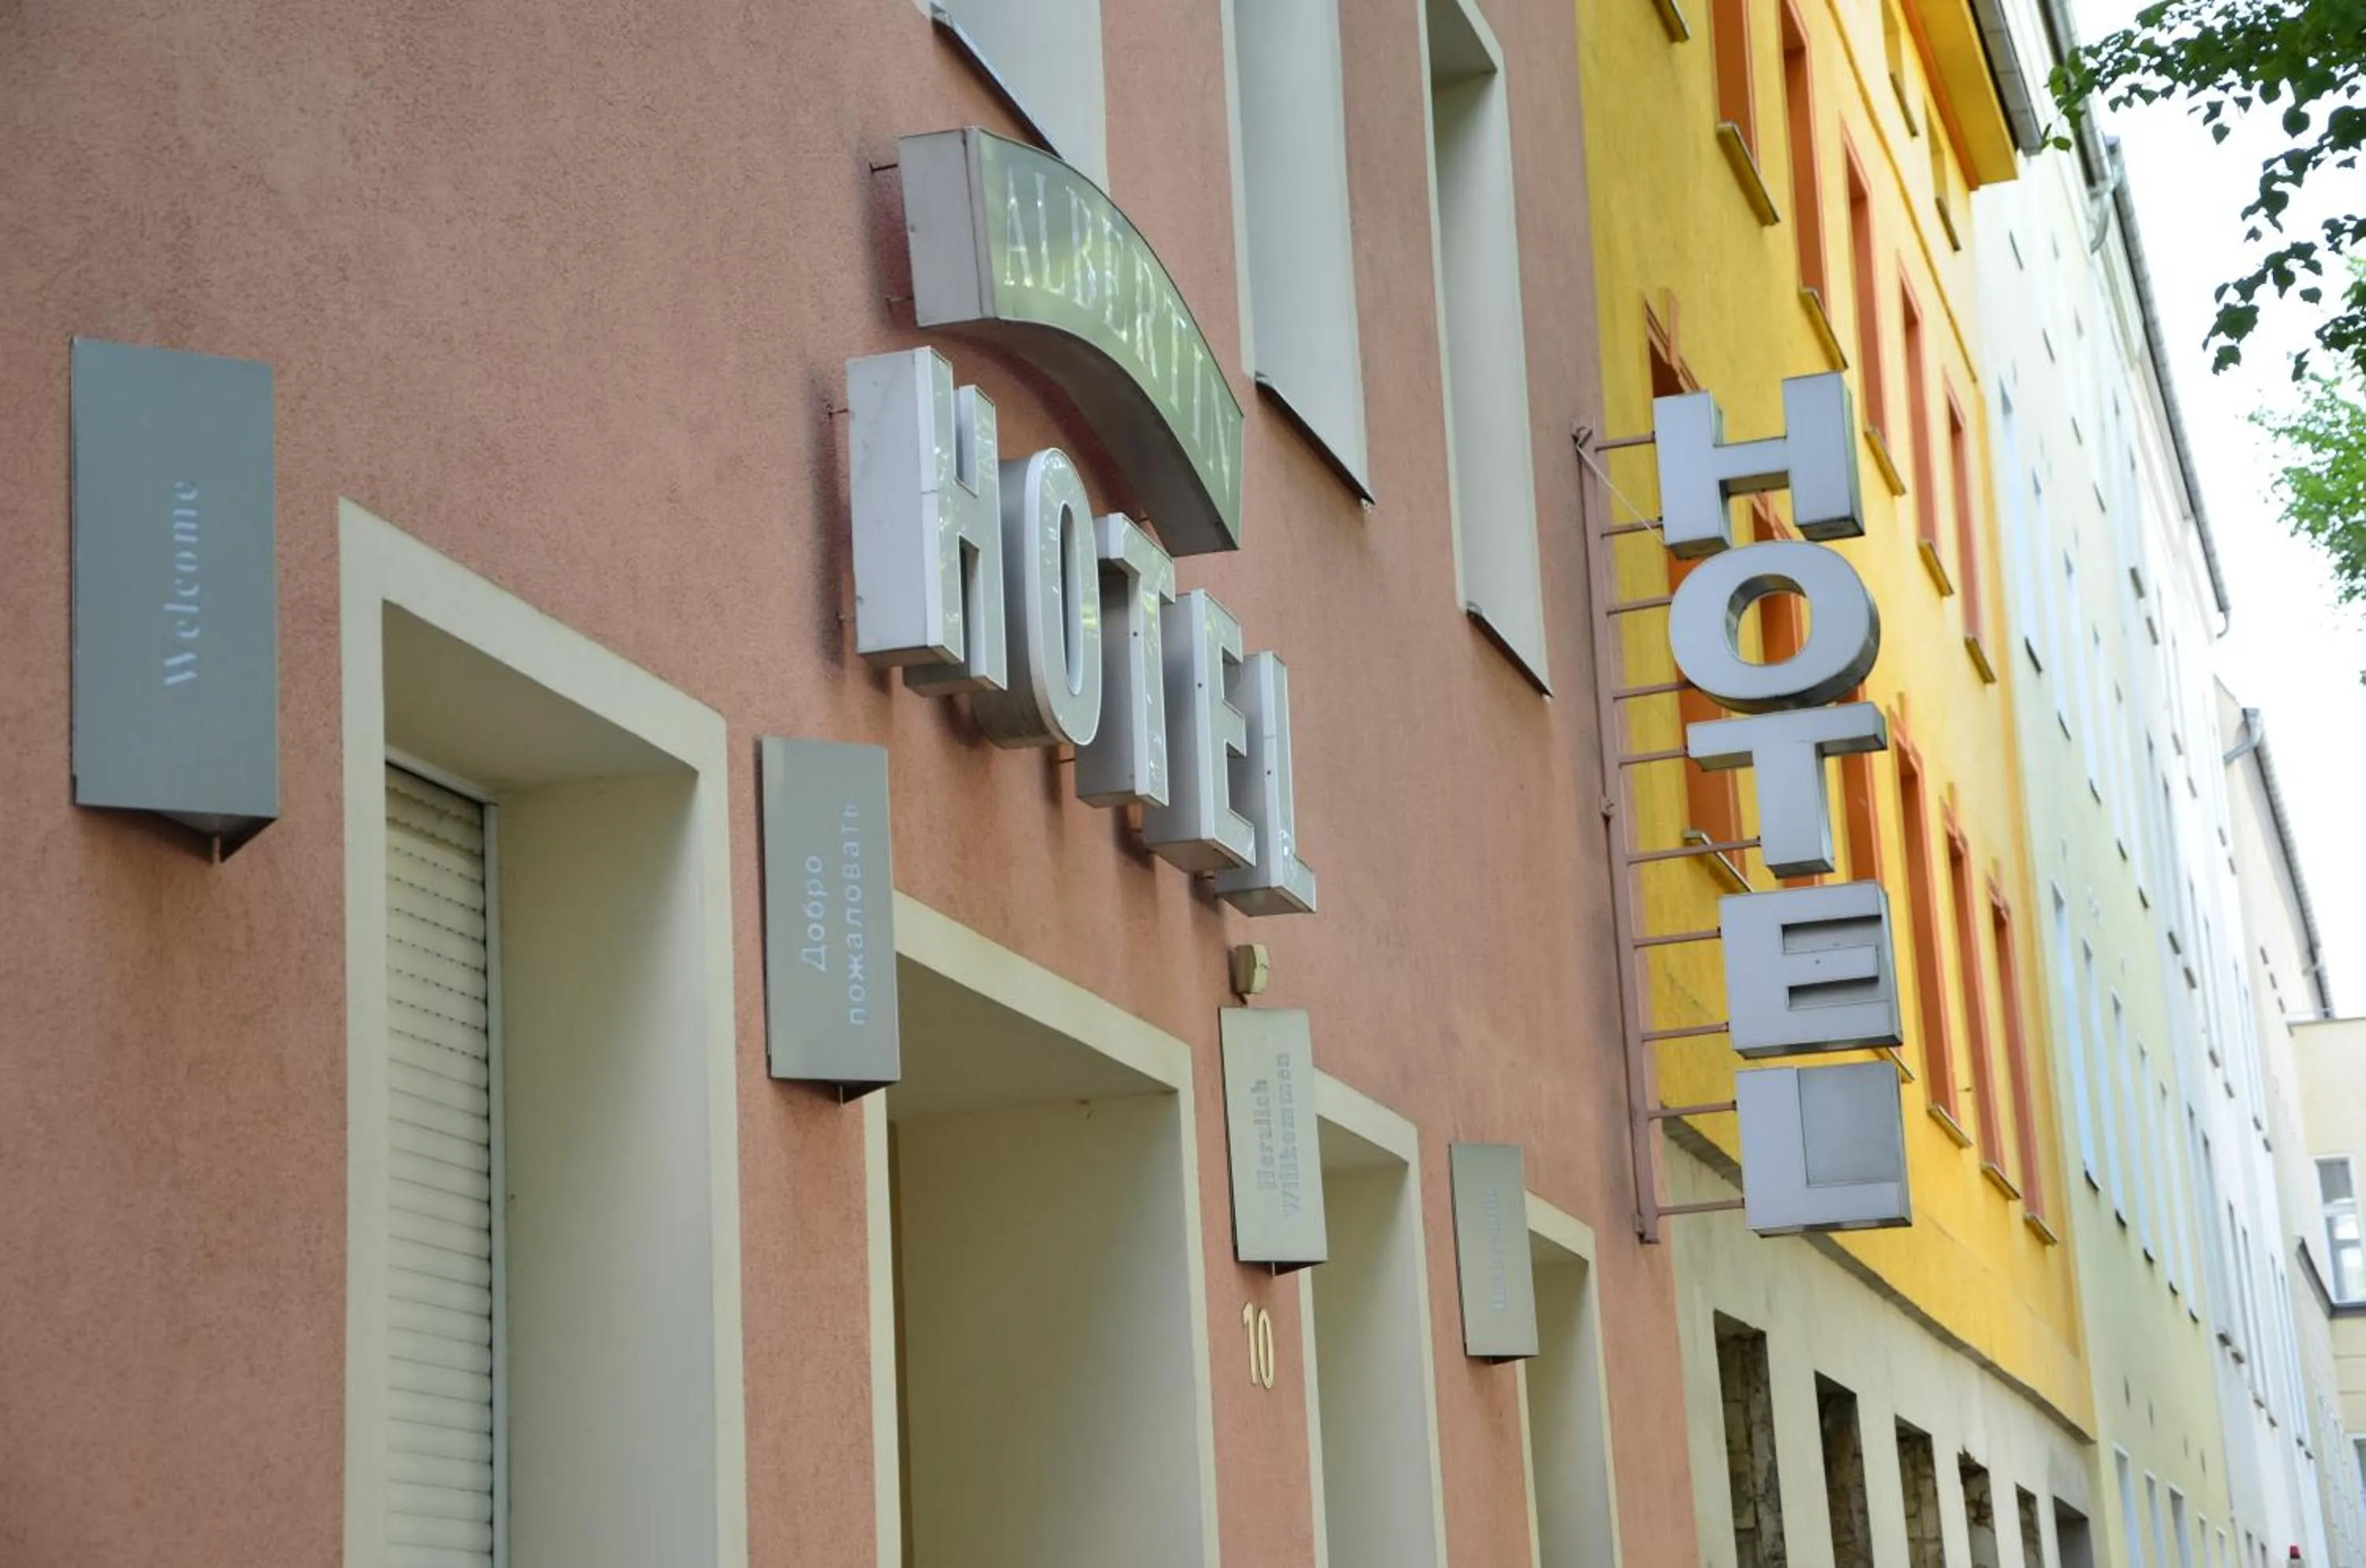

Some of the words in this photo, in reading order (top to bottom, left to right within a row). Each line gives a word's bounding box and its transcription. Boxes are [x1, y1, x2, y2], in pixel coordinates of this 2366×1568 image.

[1003, 164, 1235, 502] ALBERTIN
[163, 480, 200, 686] Welcome
[911, 345, 1315, 913] HOTEL
[800, 854, 828, 973] Добро
[841, 803, 866, 1025] пожаловать
[1653, 371, 1912, 1237] HOTEL
[1242, 1301, 1275, 1390] 10
